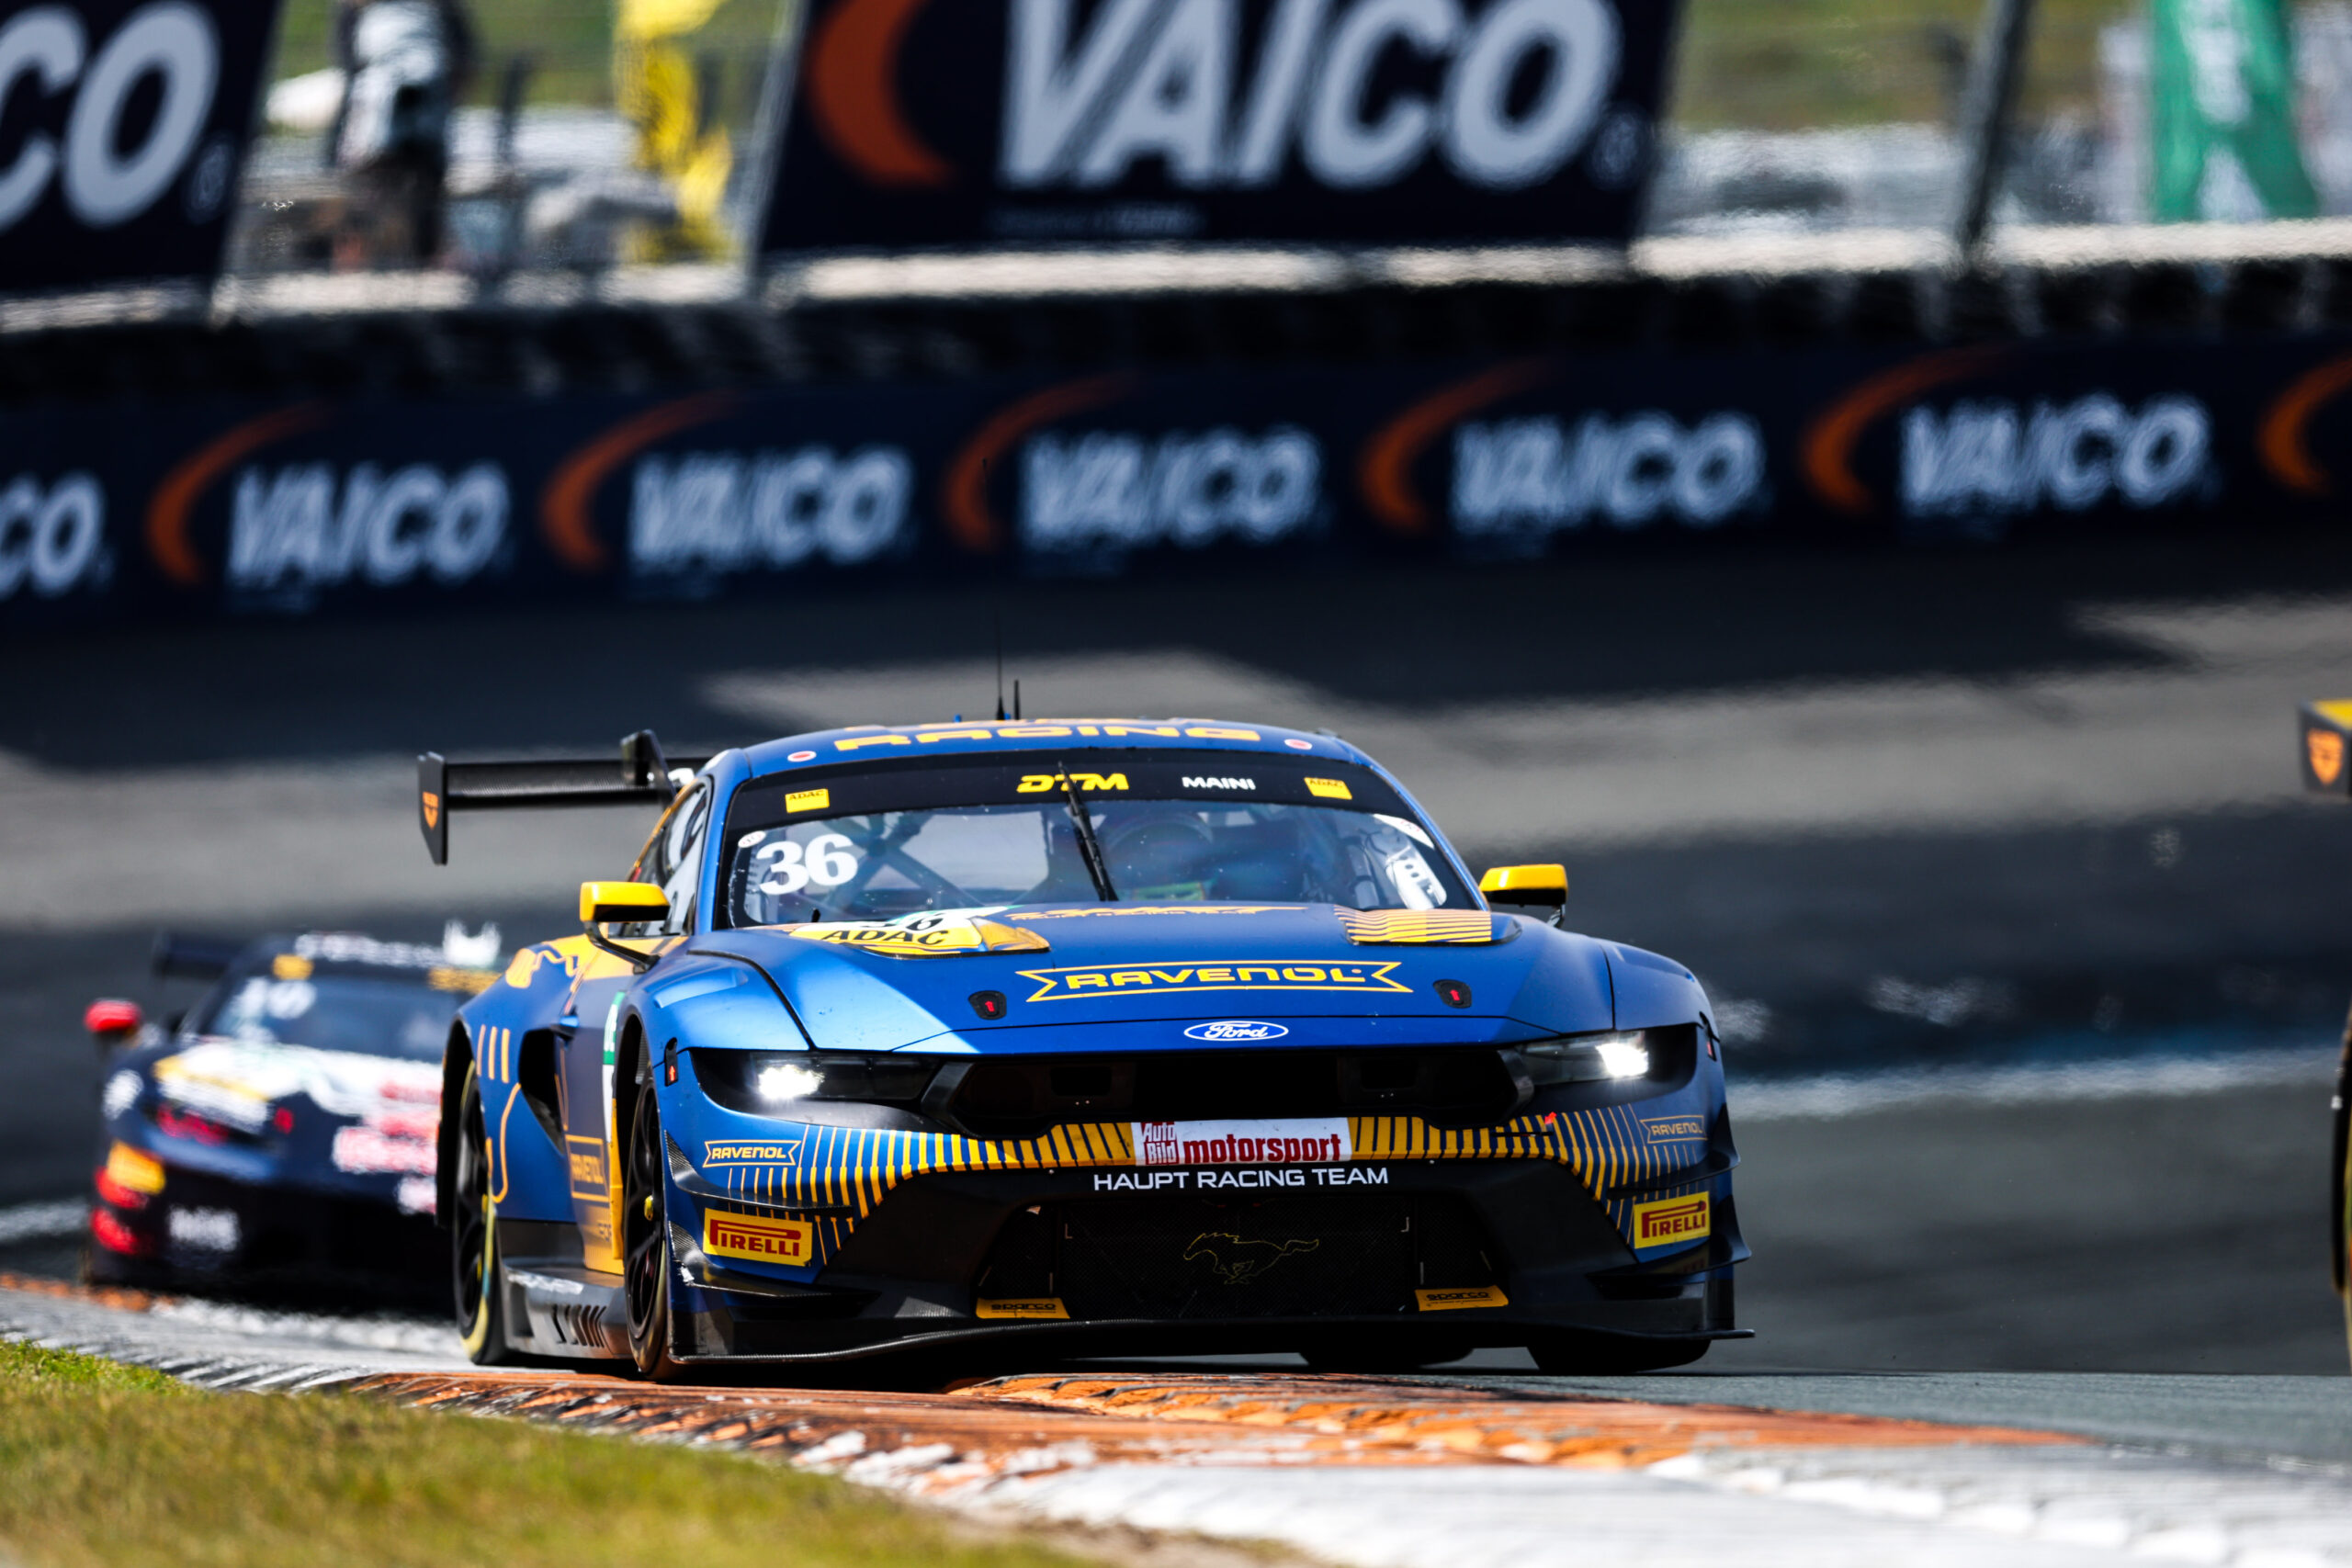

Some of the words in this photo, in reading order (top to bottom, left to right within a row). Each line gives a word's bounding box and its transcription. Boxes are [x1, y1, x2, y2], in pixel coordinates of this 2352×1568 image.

[1000, 0, 1619, 186] VAICO
[1904, 395, 2208, 509] VAICO
[230, 466, 508, 581] VAICO
[1017, 773, 1129, 793] DTM
[1182, 776, 1257, 790] MAINI
[755, 833, 858, 896] 36
[821, 929, 949, 945] ADAC
[1065, 967, 1367, 989] RAVENOL
[1204, 1022, 1270, 1039] Ford
[1143, 1122, 1177, 1142] Auto
[711, 1146, 787, 1160] RAVENOL
[1147, 1141, 1178, 1164] Bild
[1183, 1134, 1341, 1165] motorsport
[1093, 1171, 1190, 1191] HAUPT
[1197, 1169, 1306, 1189] RACING
[1311, 1168, 1389, 1186] TEAM
[1641, 1201, 1707, 1239] PIRELLI
[709, 1218, 802, 1258] PIRELLI
